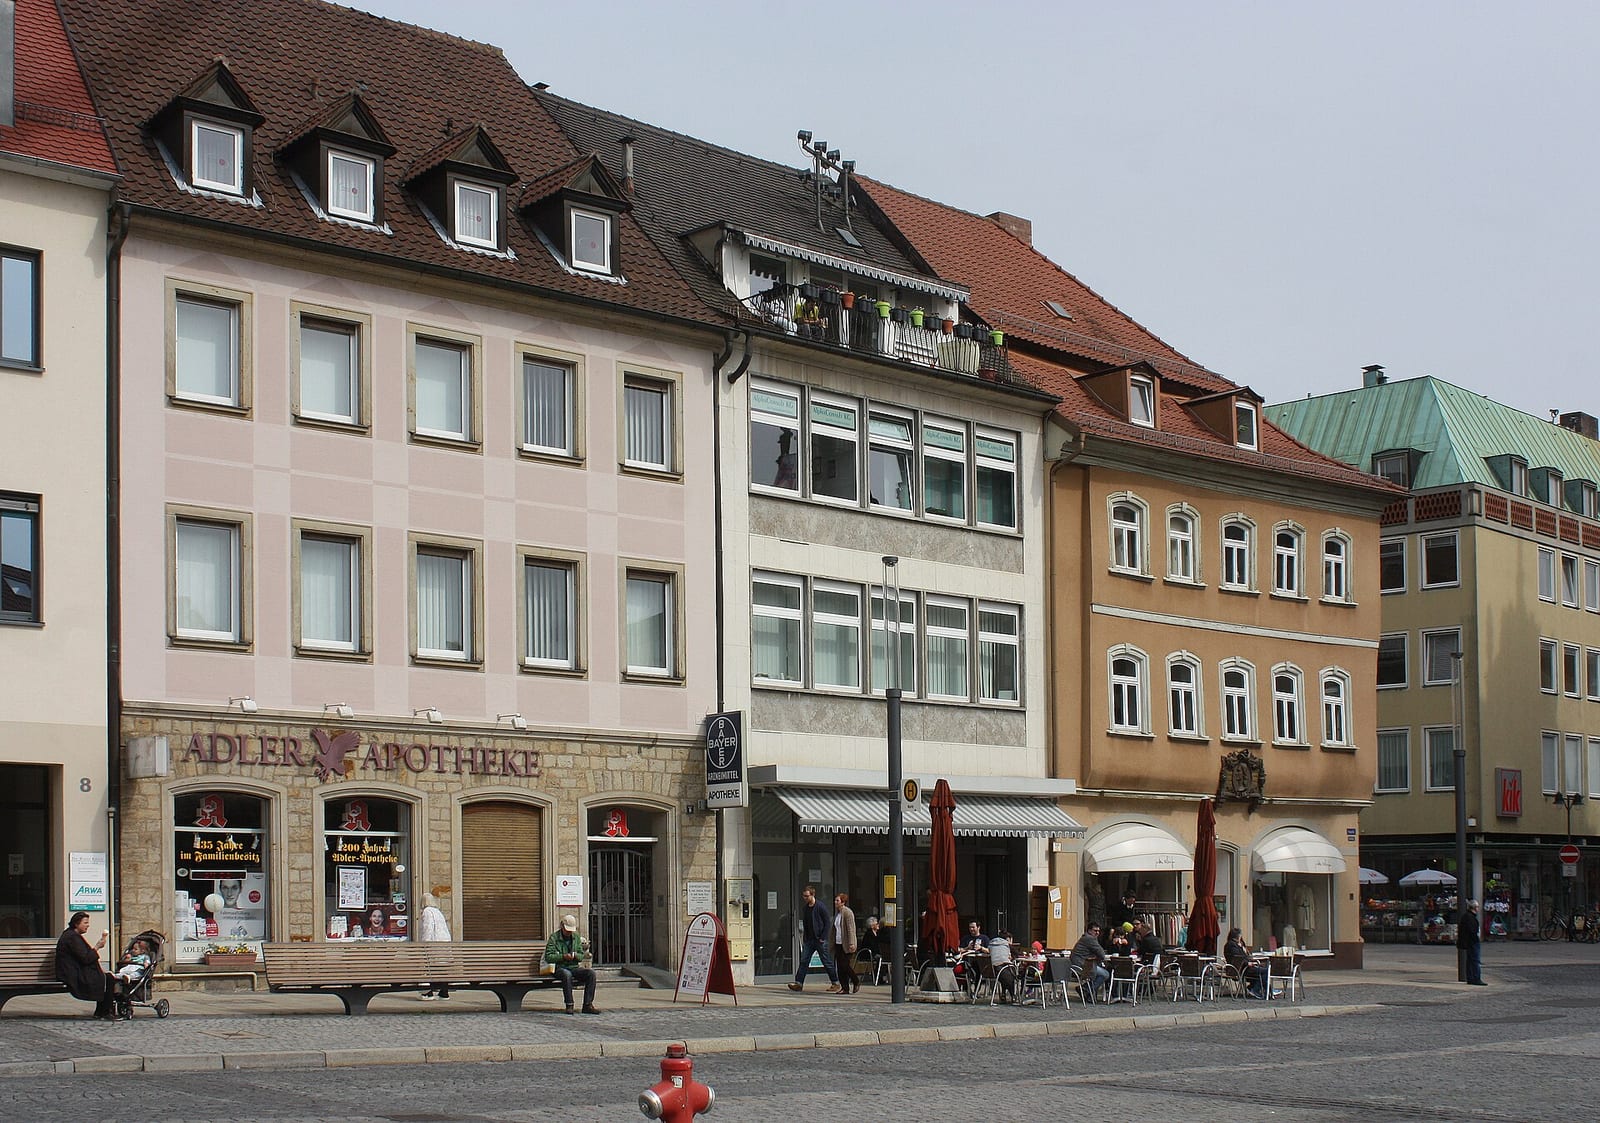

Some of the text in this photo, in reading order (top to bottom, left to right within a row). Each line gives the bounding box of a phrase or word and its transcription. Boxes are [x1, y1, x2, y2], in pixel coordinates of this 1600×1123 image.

[708, 737, 736, 749] BAYER
[185, 733, 542, 776] ADLER APOTHEKE
[80, 778, 91, 792] 8
[709, 790, 740, 800] APOTHEKE
[216, 840, 244, 851] Jahre
[342, 843, 388, 853] 200 Jahre
[180, 850, 260, 863] im Familienbesitz
[332, 853, 398, 864] Adler-Apotheke
[75, 886, 102, 896] ARWA
